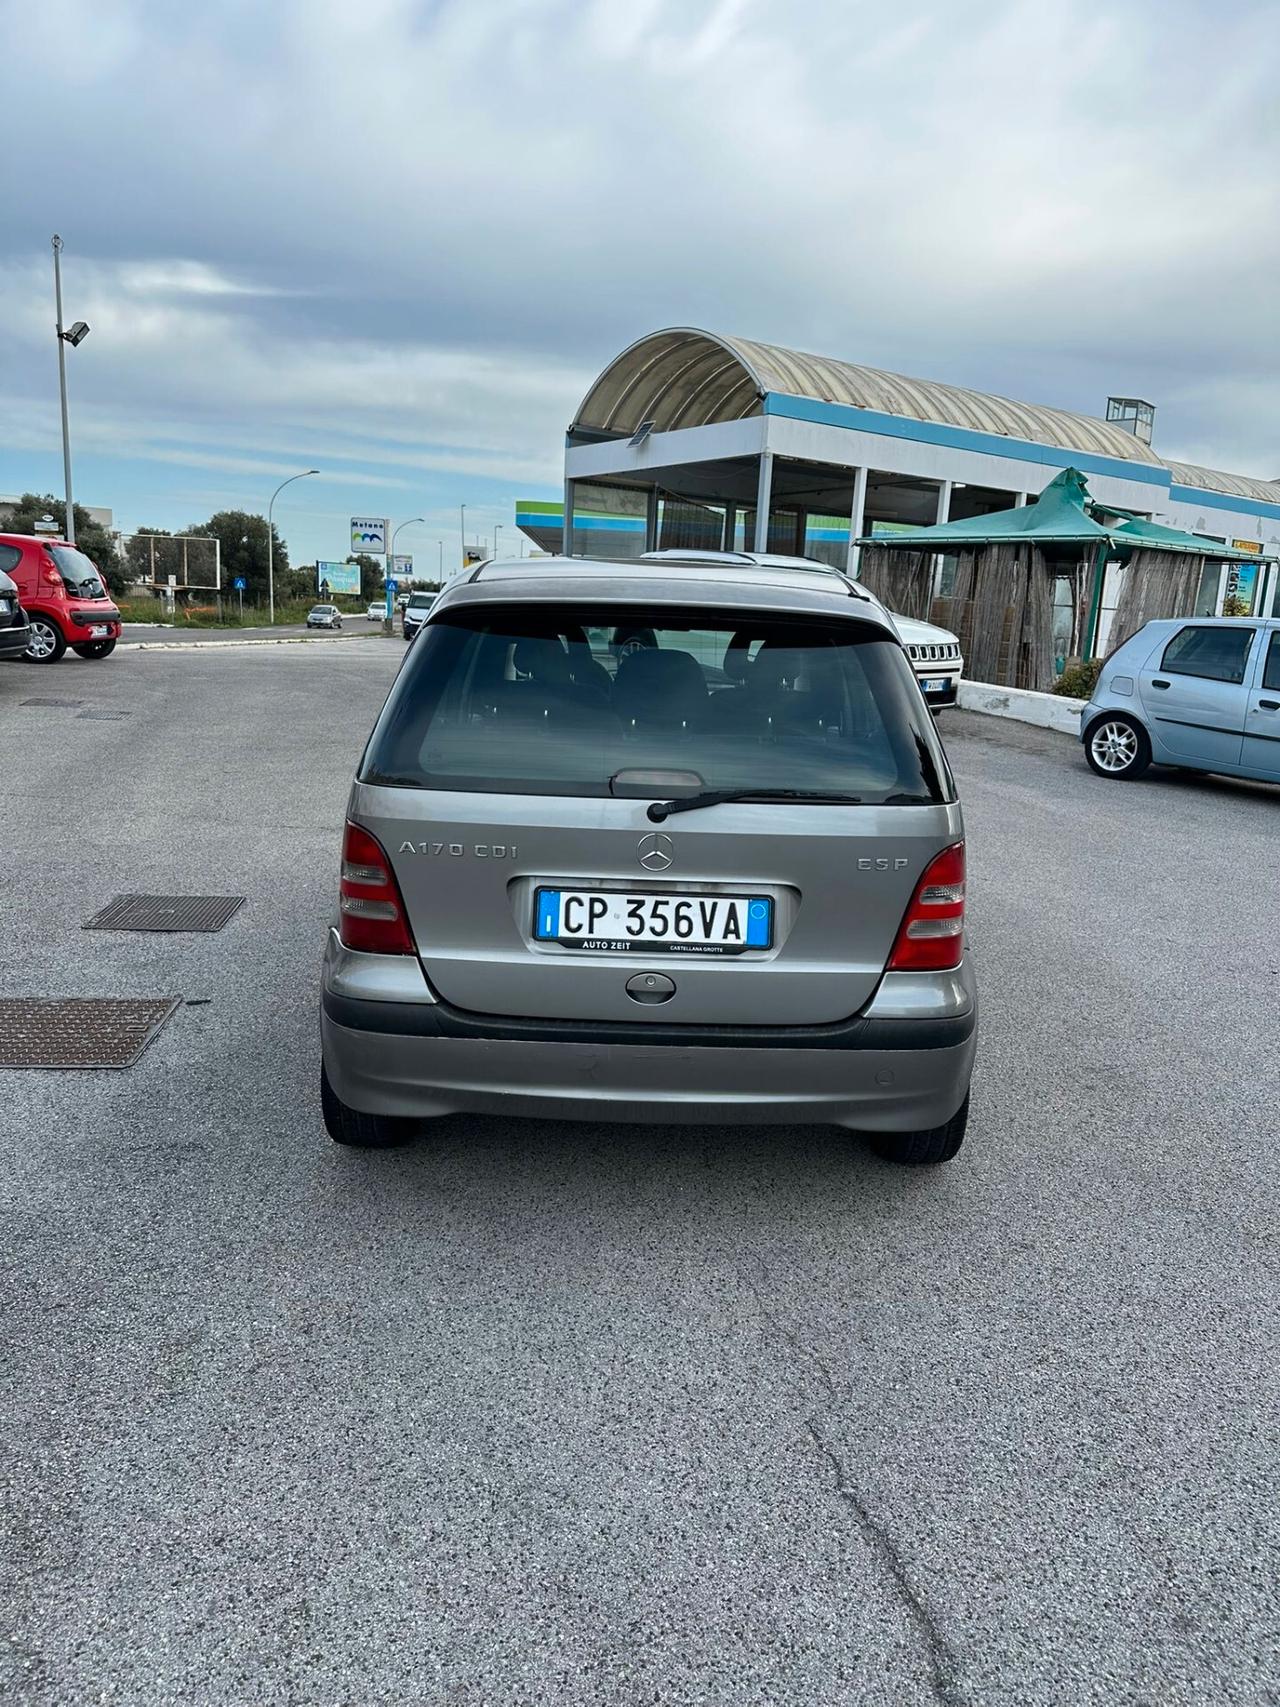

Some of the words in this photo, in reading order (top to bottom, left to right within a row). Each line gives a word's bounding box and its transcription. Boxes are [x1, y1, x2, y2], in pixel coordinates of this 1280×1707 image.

[399, 841, 464, 856] A170
[475, 845, 517, 858] CDI
[858, 858, 908, 870] ESP
[564, 896, 608, 934] CP
[625, 899, 741, 940] 356VA
[582, 941, 608, 949] AUTO
[610, 942, 631, 950] ZEIT
